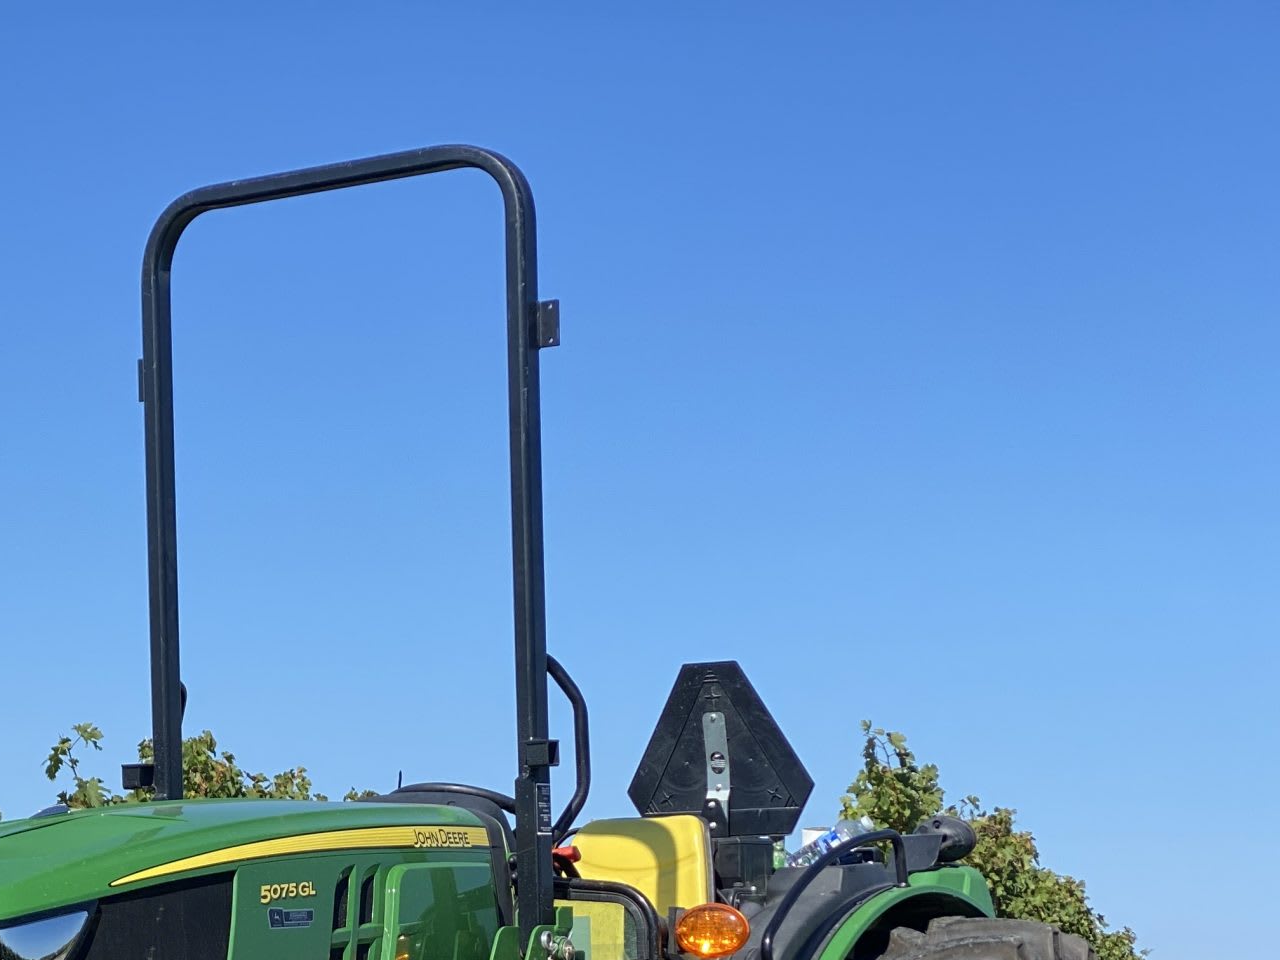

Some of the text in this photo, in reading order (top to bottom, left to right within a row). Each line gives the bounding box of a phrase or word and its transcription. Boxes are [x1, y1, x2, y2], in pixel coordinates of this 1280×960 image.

[413, 828, 472, 847] JOHN DEERE
[260, 880, 317, 904] 5075 GL
